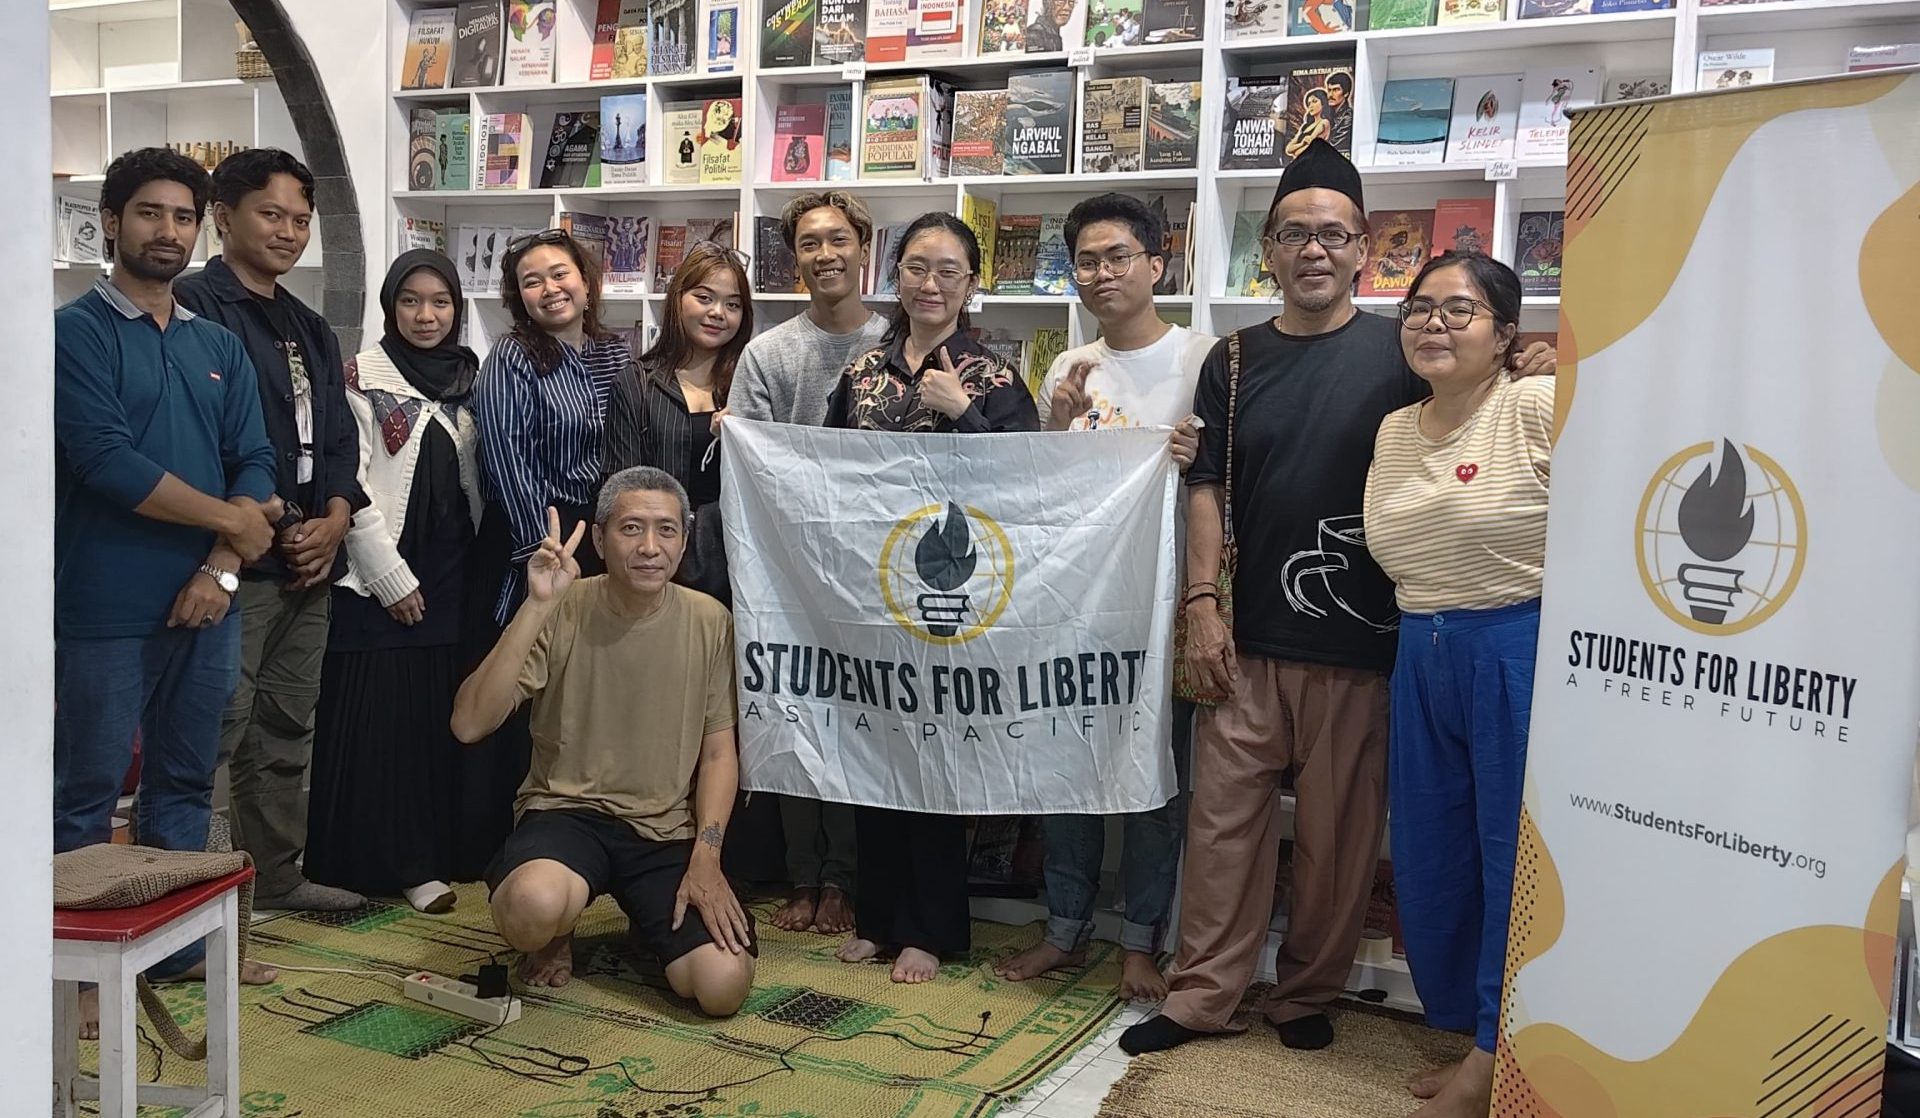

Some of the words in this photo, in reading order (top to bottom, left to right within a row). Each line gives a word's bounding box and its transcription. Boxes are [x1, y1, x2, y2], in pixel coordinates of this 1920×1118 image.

[822, 5, 844, 14] DARI
[921, 2, 955, 10] INDONESIA
[821, 13, 856, 23] DALAM
[875, 8, 909, 17] BAHASA
[418, 27, 445, 36] FILSAFAT
[458, 17, 499, 40] DIGITALITAS
[597, 24, 618, 33] PENG
[419, 37, 441, 45] HUKUM
[651, 44, 688, 55] SEJARAH
[651, 54, 685, 64] FILSAFAT
[651, 63, 687, 73] YUNANI
[1233, 119, 1276, 134] ANWAR
[1467, 126, 1501, 137] KELIR
[1013, 127, 1062, 142] LARVHUL
[1085, 133, 1107, 141] KELAS
[1528, 129, 1568, 138] TELEMB
[478, 117, 488, 162] TEOLOGI
[1233, 133, 1275, 149] TOHARI
[1458, 139, 1504, 151] SLINDET
[564, 143, 588, 153] AGAMA
[867, 143, 914, 154] PENDIDIKAN
[1012, 141, 1060, 155] NGABAL
[1231, 147, 1258, 156] MENCARI
[1258, 147, 1273, 155] MATI
[703, 153, 731, 164] Filsafat
[867, 151, 914, 161] POPULAR
[704, 164, 728, 175] Politik
[476, 165, 487, 187] KIRI
[971, 207, 992, 229] Arsi
[660, 239, 683, 247] Filsafat
[745, 641, 918, 714] STUDENTS
[932, 665, 1003, 715] FOR
[1567, 630, 1687, 687] STUDENTS
[1694, 651, 1739, 698] FOR
[1746, 660, 1857, 720] LIBERTY
[1566, 673, 1578, 688] A
[1603, 679, 1695, 711] FREER
[1720, 702, 1849, 743] FUTURE
[1569, 792, 1827, 879] www.StudentsForLiberty.org
